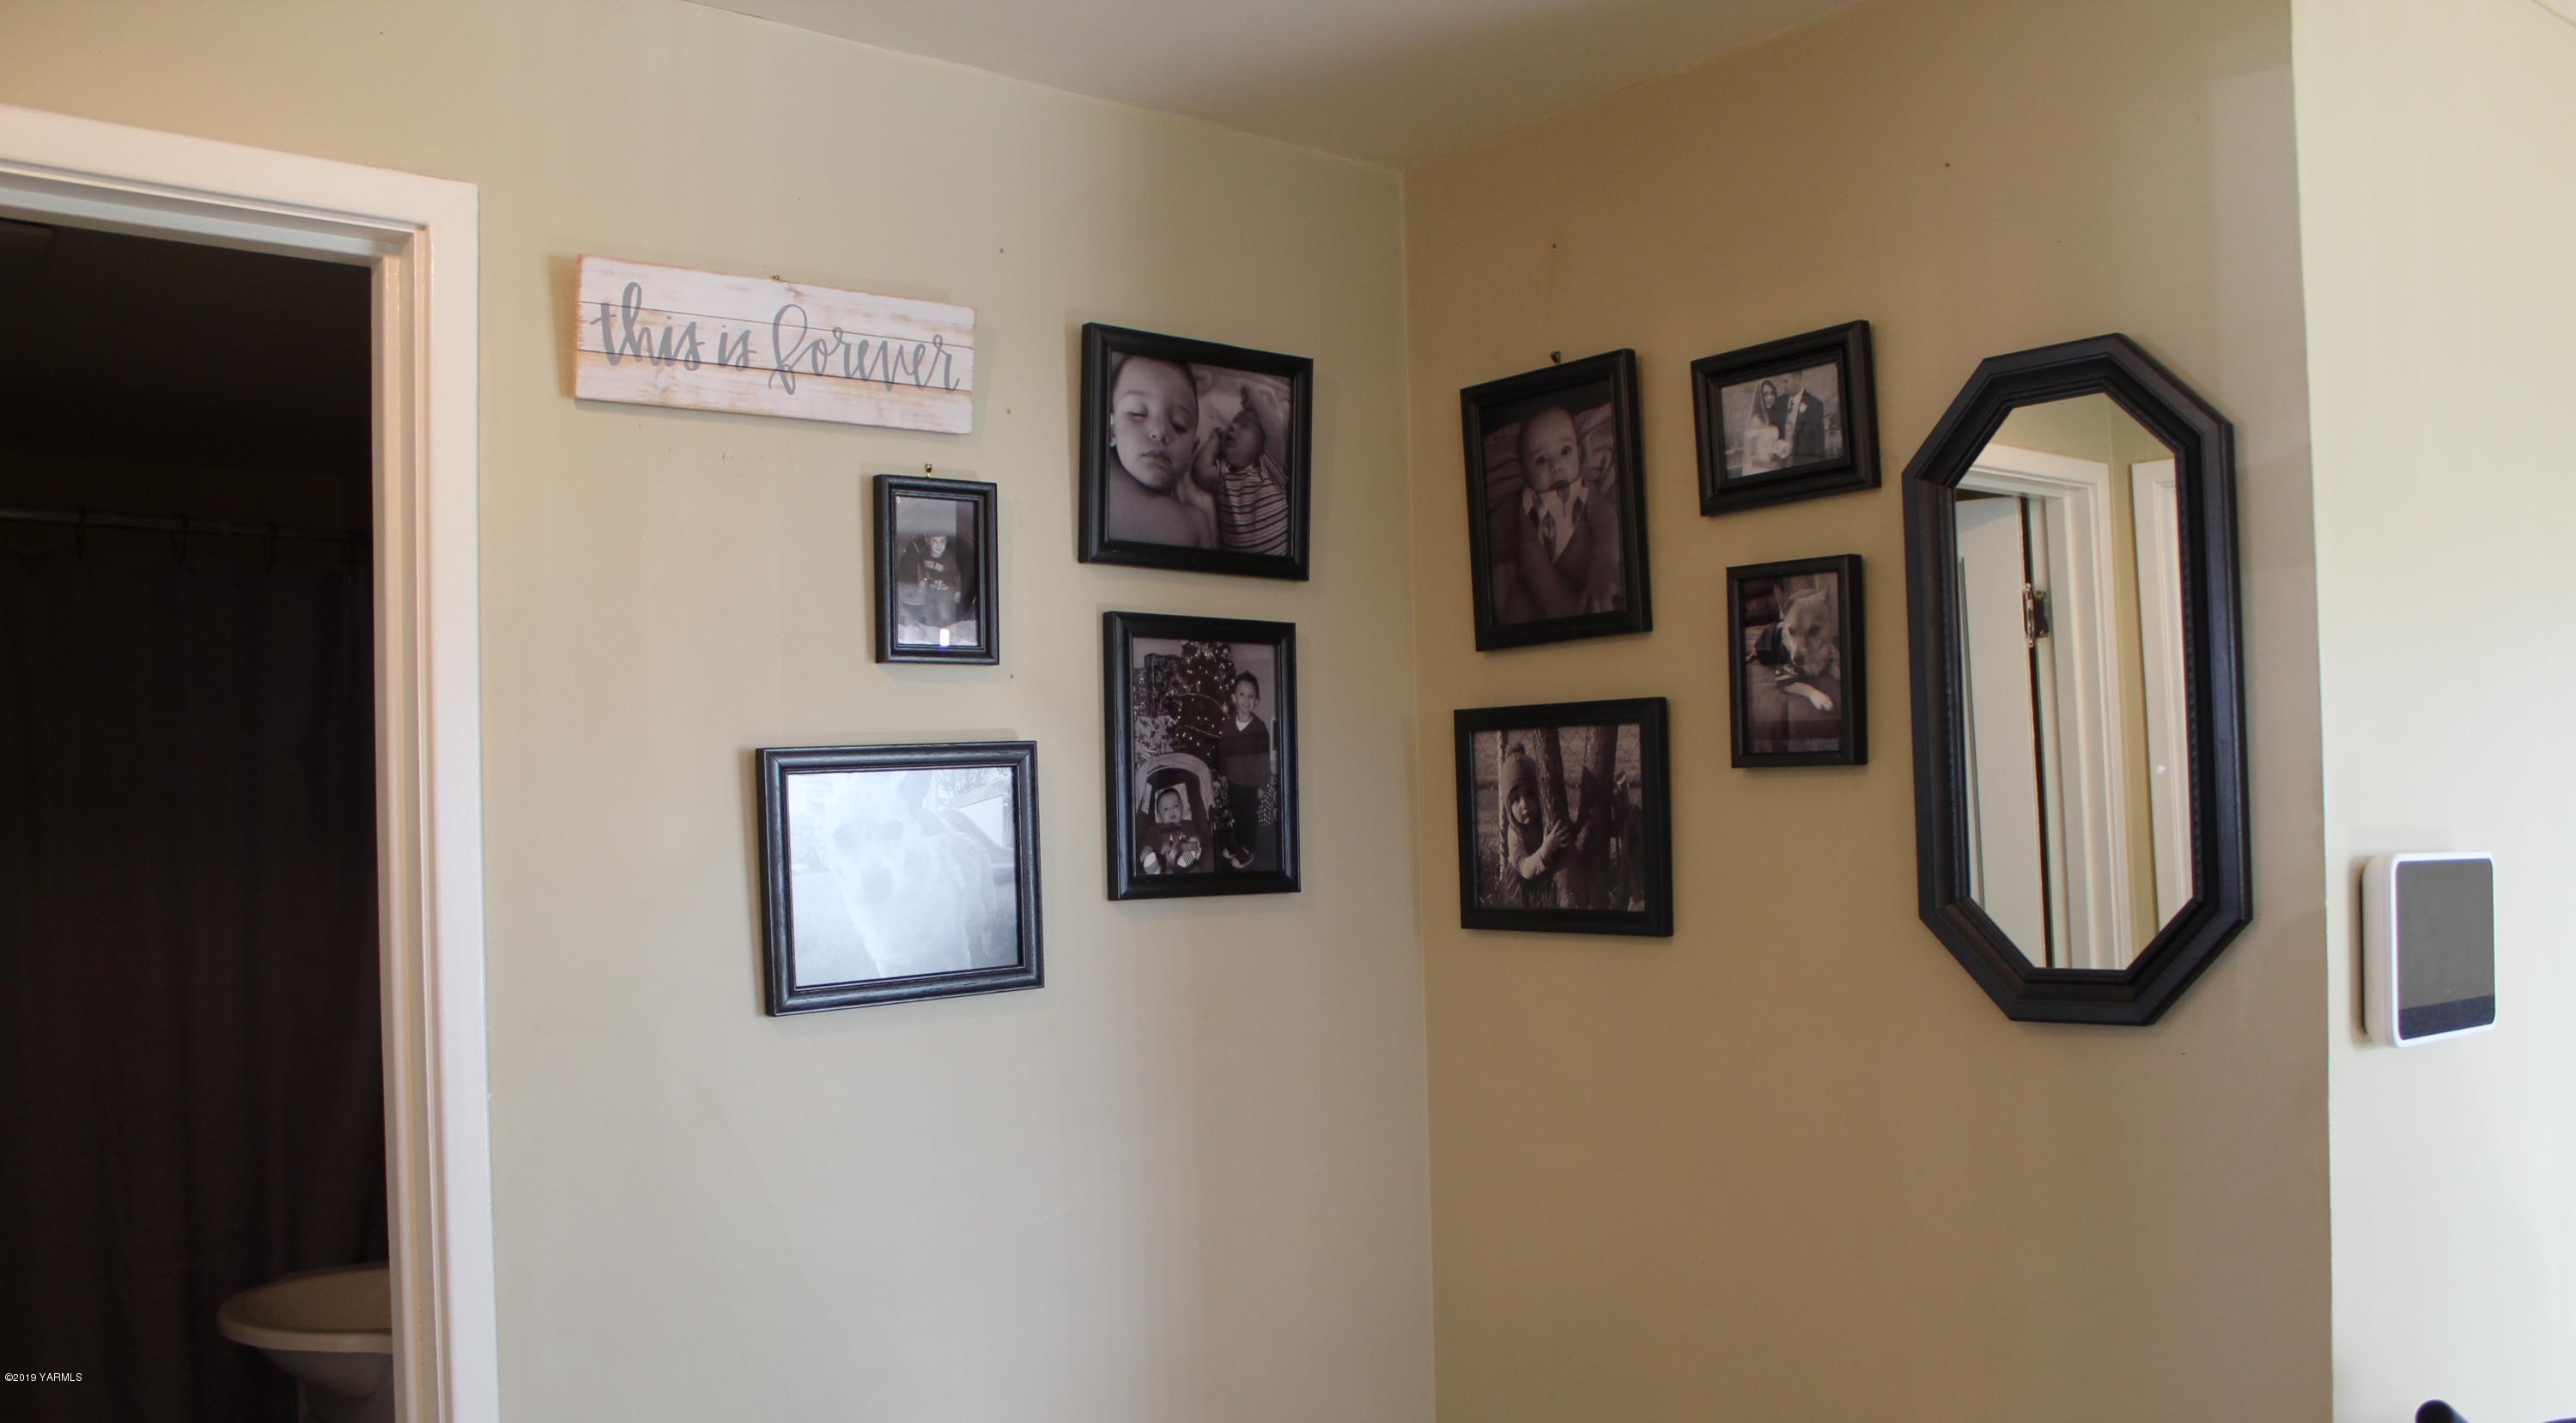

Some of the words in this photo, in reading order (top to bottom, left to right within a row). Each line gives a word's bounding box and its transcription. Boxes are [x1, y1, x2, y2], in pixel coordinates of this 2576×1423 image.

[590, 282, 705, 371] this
[717, 324, 757, 370] is
[769, 303, 960, 395] forever
